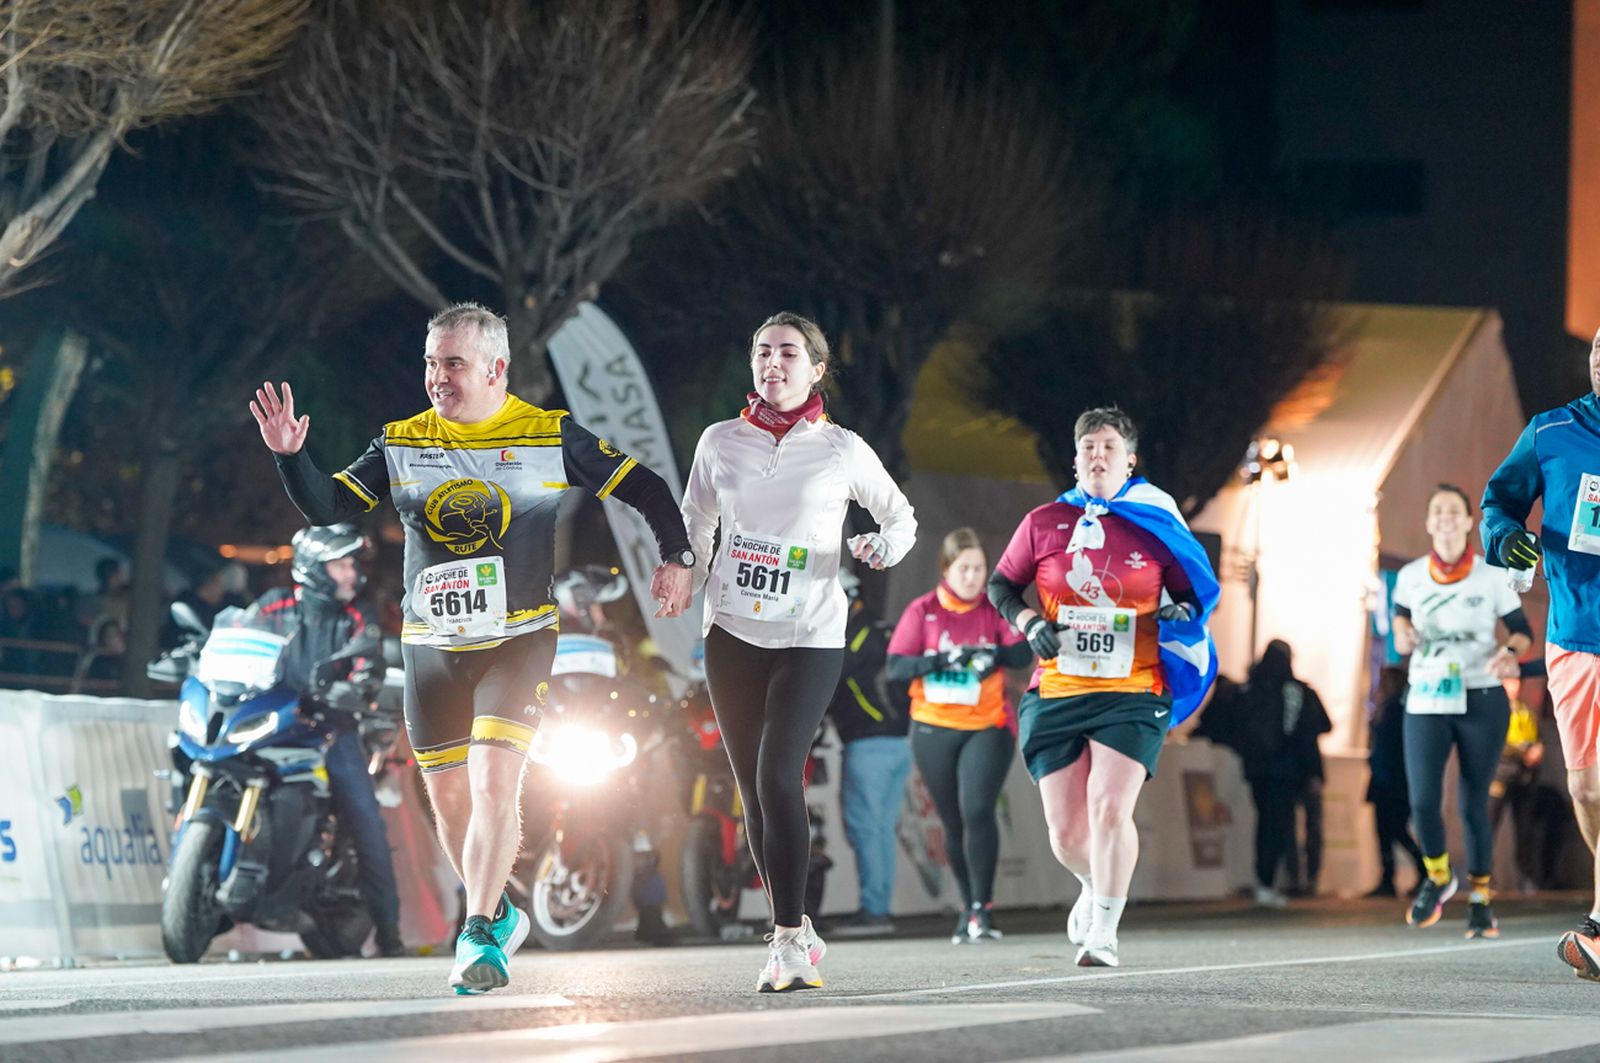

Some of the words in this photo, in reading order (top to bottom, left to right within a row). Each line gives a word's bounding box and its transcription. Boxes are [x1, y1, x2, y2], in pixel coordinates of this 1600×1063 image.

[427, 499, 438, 515] CLUB
[438, 479, 473, 499] ATLETISMO
[1587, 492, 1600, 503] SA
[454, 543, 477, 553] RUTE
[730, 549, 747, 560] SAN
[741, 541, 769, 553] NOCHE
[770, 545, 781, 555] DE
[458, 569, 468, 578] DE
[736, 562, 791, 595] 5611
[424, 582, 439, 595] SAN
[1080, 581, 1101, 600] 43
[430, 589, 488, 617] 5614
[1076, 632, 1115, 653] 569
[80, 812, 162, 881] aqualia
